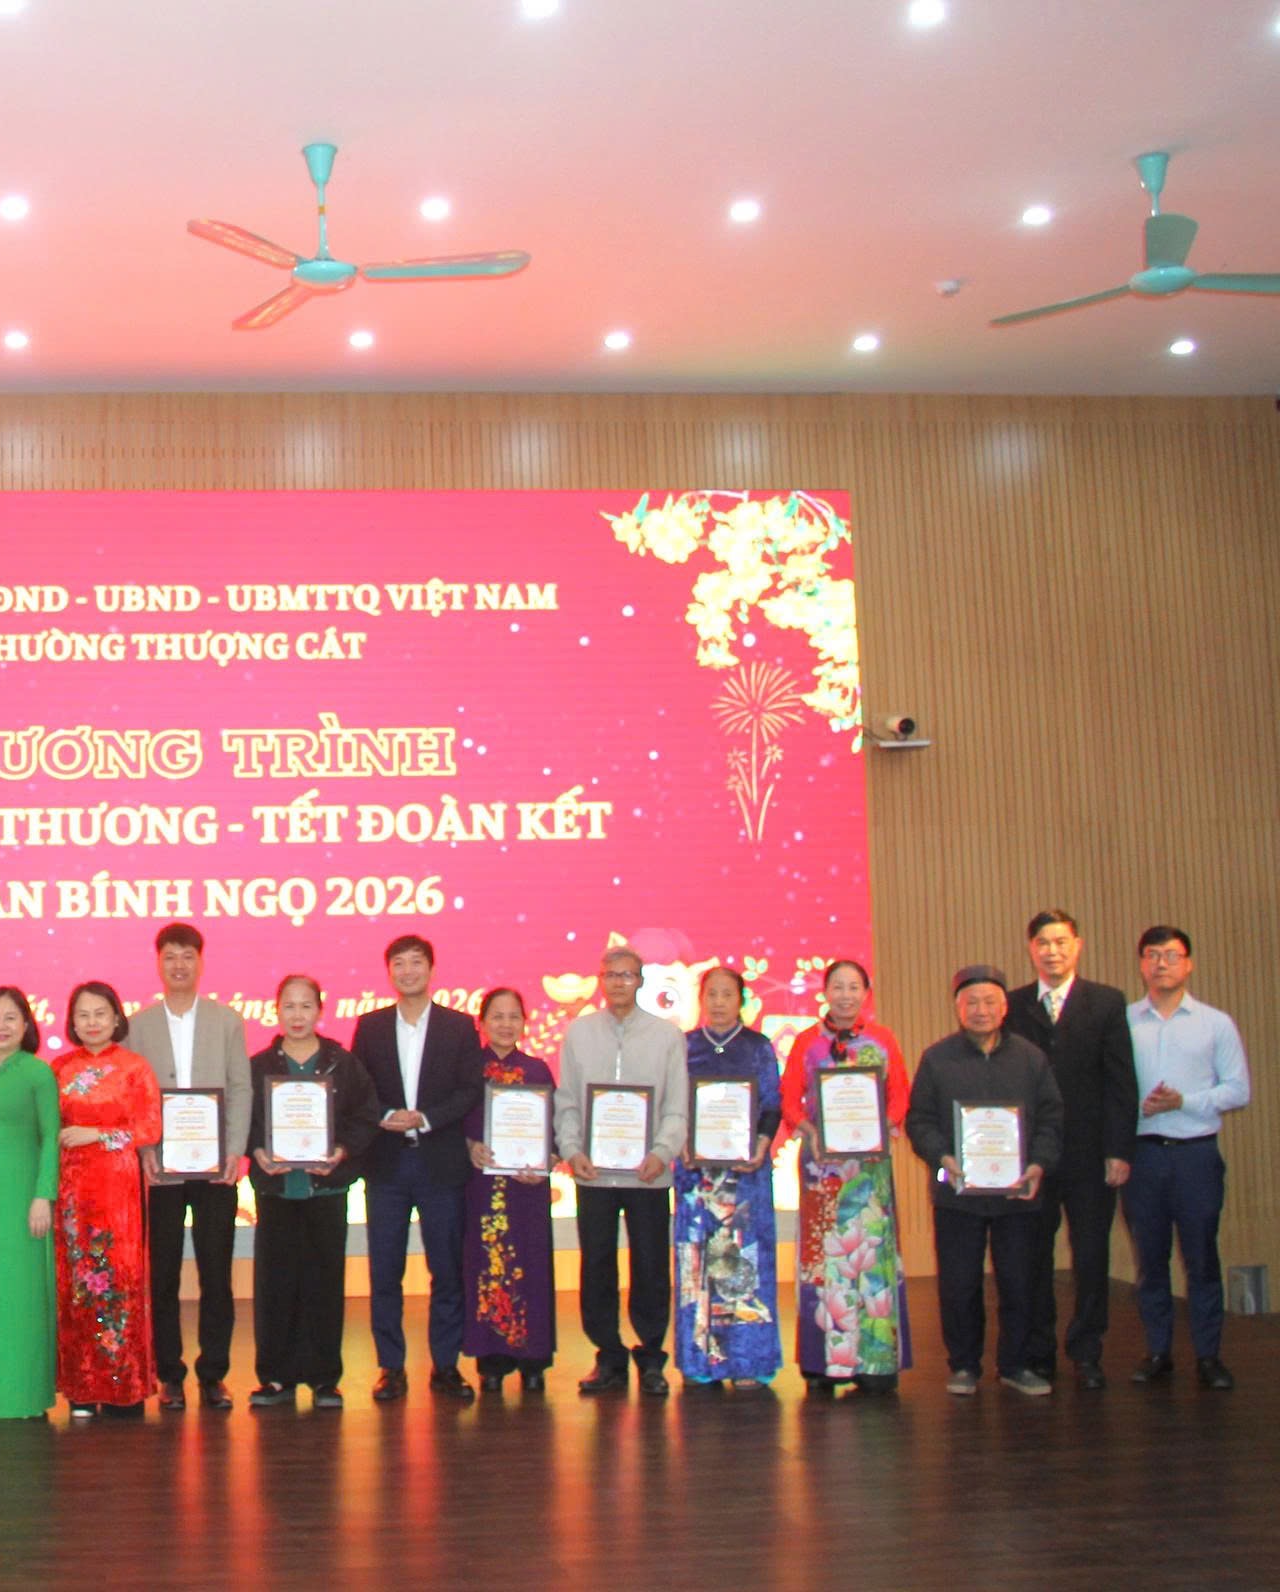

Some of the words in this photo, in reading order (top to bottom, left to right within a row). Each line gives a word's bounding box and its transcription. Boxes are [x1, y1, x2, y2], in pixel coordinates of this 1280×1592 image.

[94, 585, 202, 613] UBND
[226, 584, 382, 616] UBMTTQ
[385, 577, 468, 617] VIỆT
[474, 583, 559, 611] NAM
[131, 630, 289, 667] THƯỢNG
[295, 627, 367, 660] CÁT
[221, 712, 457, 779] TRÌNH
[251, 789, 349, 844] TẾT
[356, 794, 508, 842] ĐOÀN
[515, 784, 613, 841] KẾT
[56, 870, 193, 918] BÍNH
[202, 878, 317, 926] NGỌ
[325, 876, 445, 917] 2026
